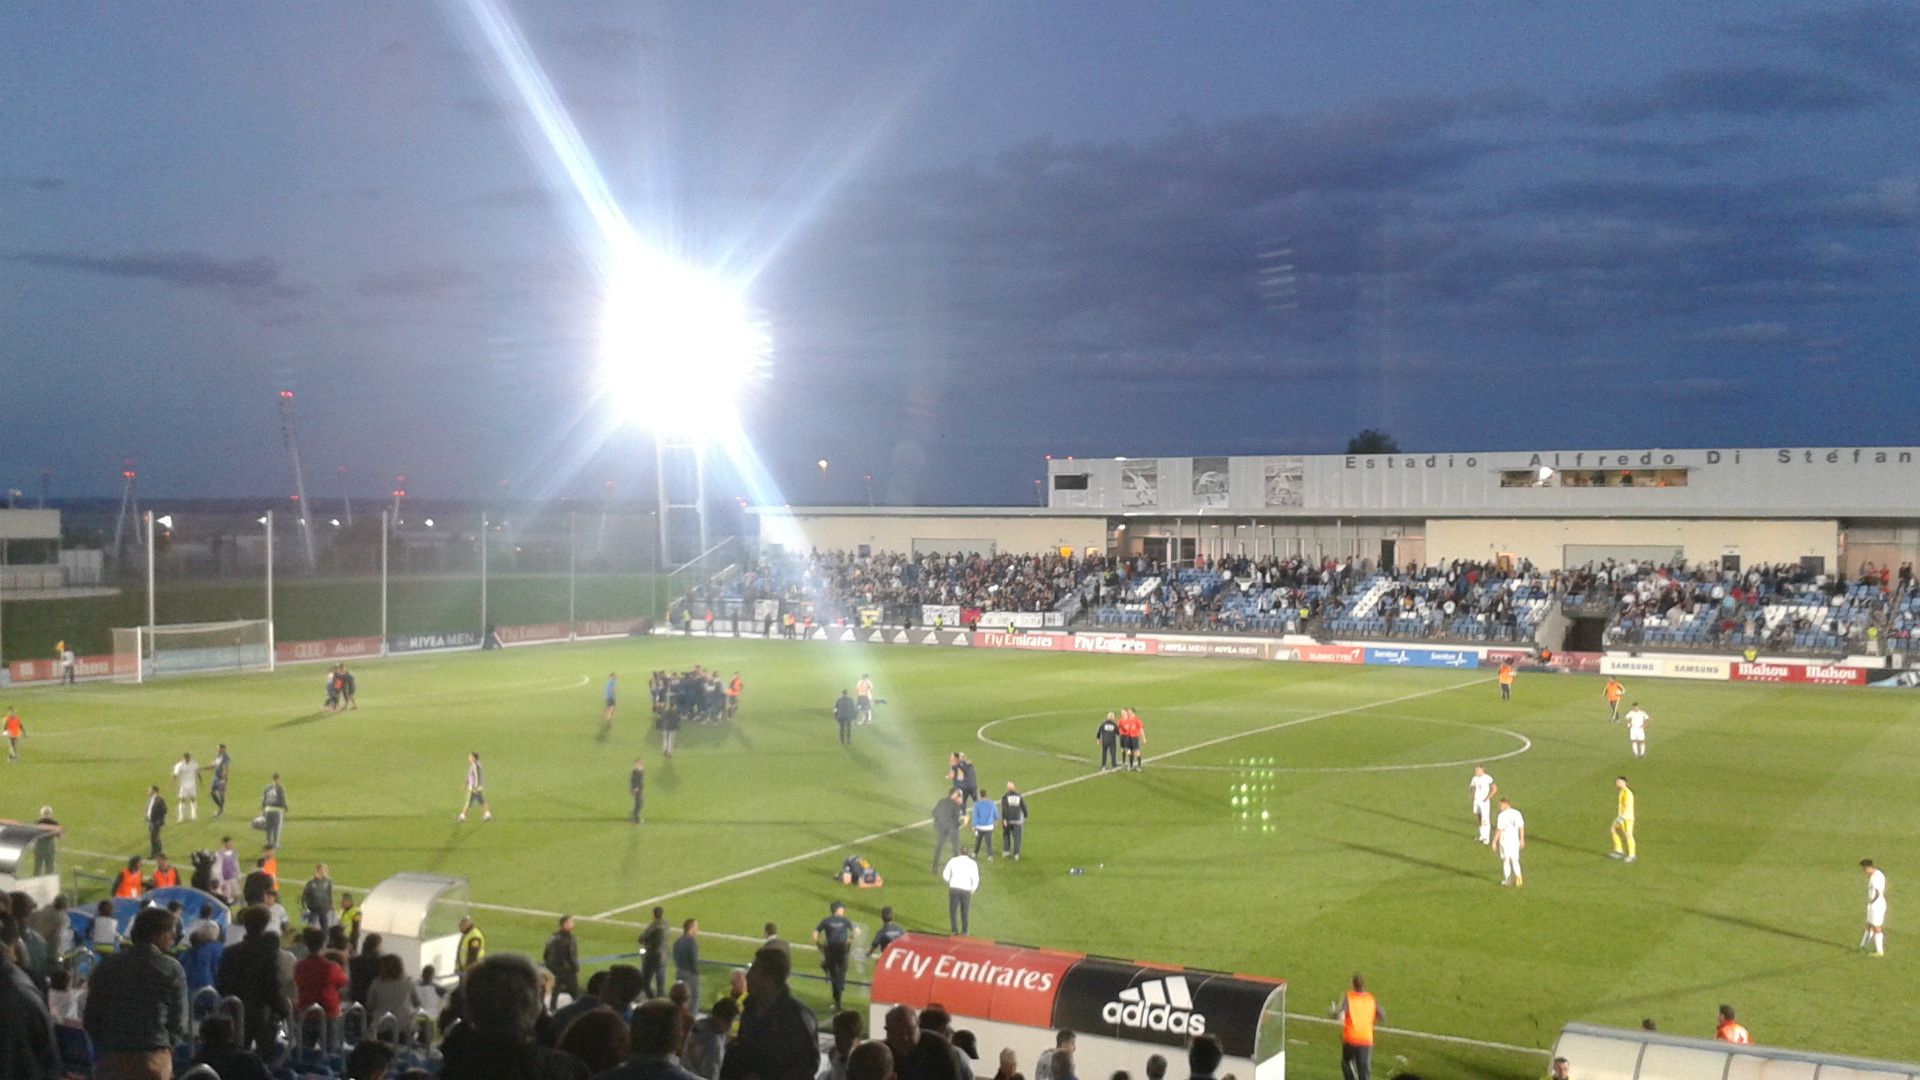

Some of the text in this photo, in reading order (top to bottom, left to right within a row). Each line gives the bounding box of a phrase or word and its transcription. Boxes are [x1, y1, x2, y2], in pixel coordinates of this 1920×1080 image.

[1345, 456, 1477, 469] Estadio
[1530, 451, 1675, 468] Alfredo
[1706, 449, 1741, 465] Di
[409, 635, 446, 648] NIVEA
[985, 633, 1053, 647] Fly Emirates
[1075, 636, 1096, 651] Fly
[1611, 661, 1654, 671] SAMSUNG
[1674, 664, 1719, 674] SAMSUNG
[1738, 663, 1788, 677] Mahou
[1806, 666, 1857, 679] Mahou
[884, 947, 1054, 992] Fly Emirates
[1102, 999, 1206, 1037] adidas
